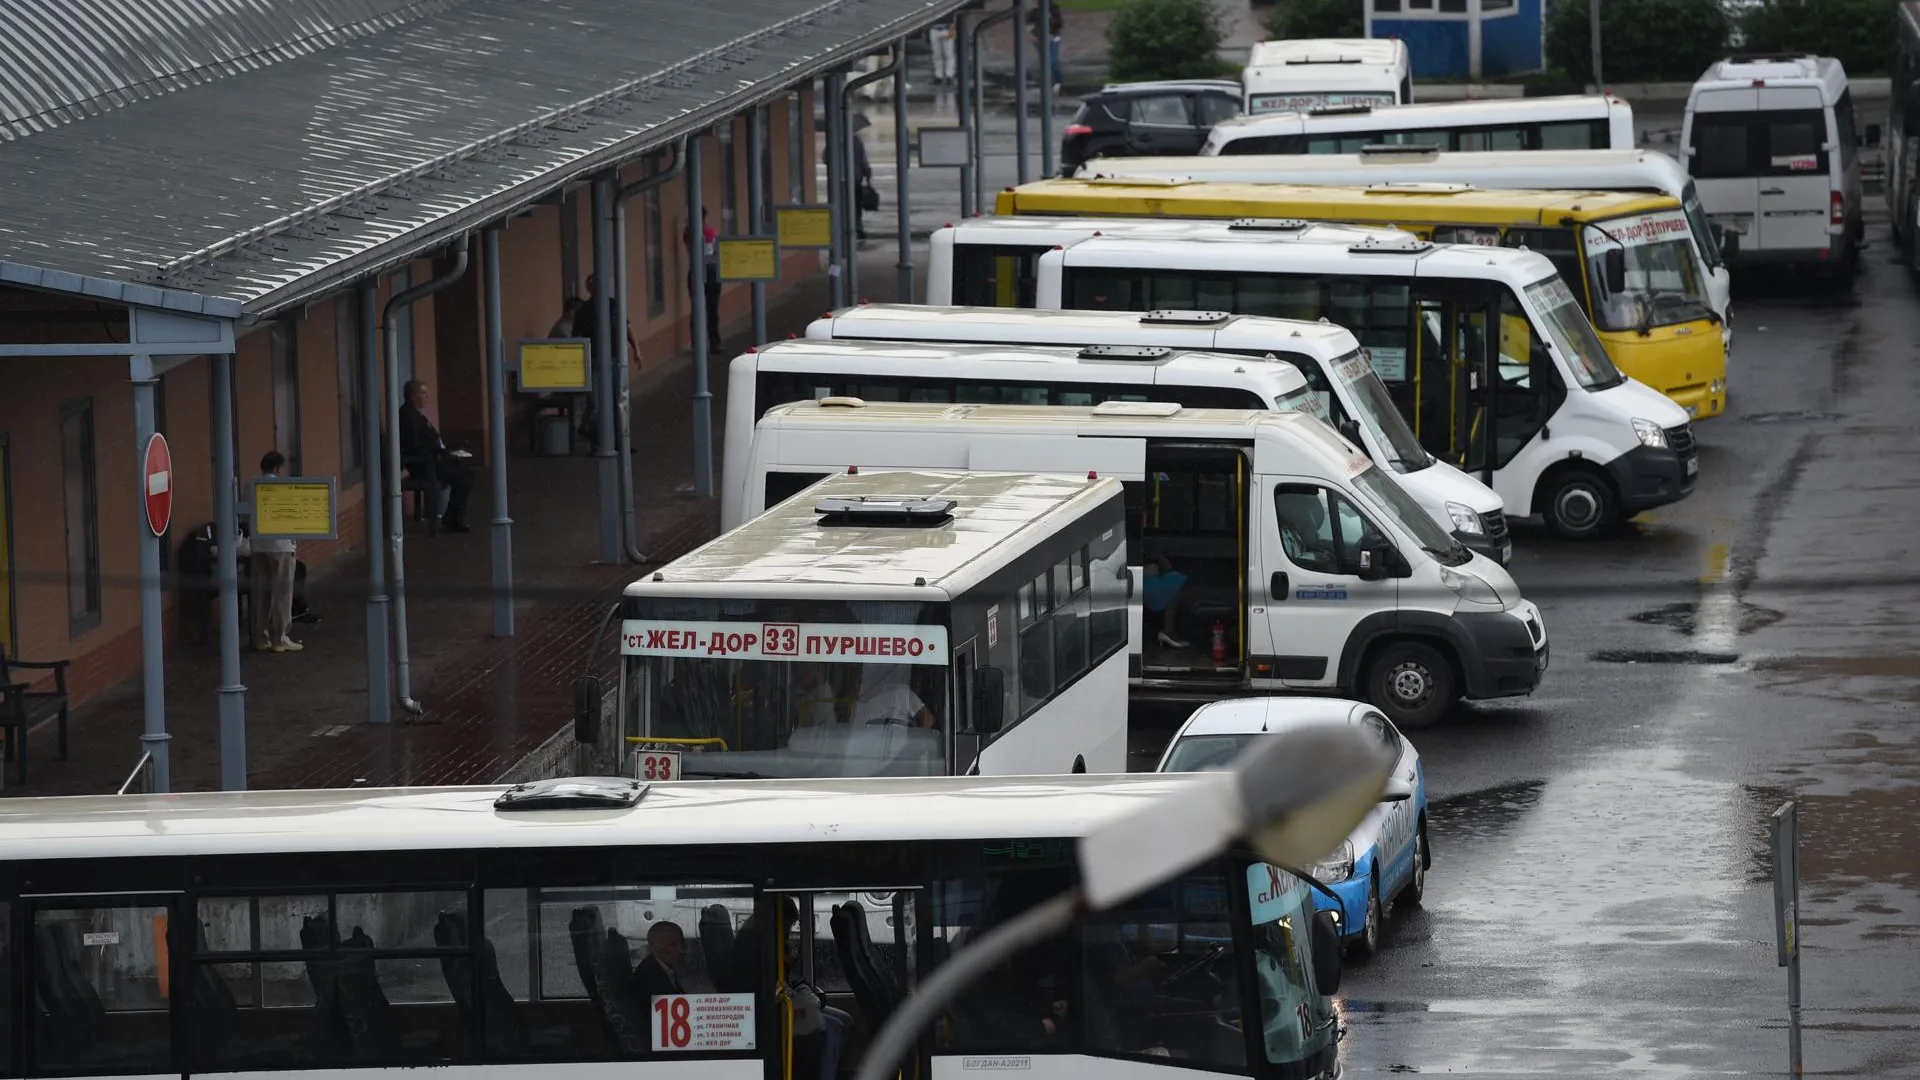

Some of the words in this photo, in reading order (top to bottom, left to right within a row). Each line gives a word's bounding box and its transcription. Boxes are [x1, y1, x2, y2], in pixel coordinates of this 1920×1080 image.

[646, 629, 758, 655] ЖЕЛ-ДОР
[765, 628, 796, 651] 33
[806, 635, 924, 657] ПУРШЕВО
[644, 756, 671, 780] 33
[655, 997, 691, 1048] 18
[1296, 1003, 1312, 1040] 18
